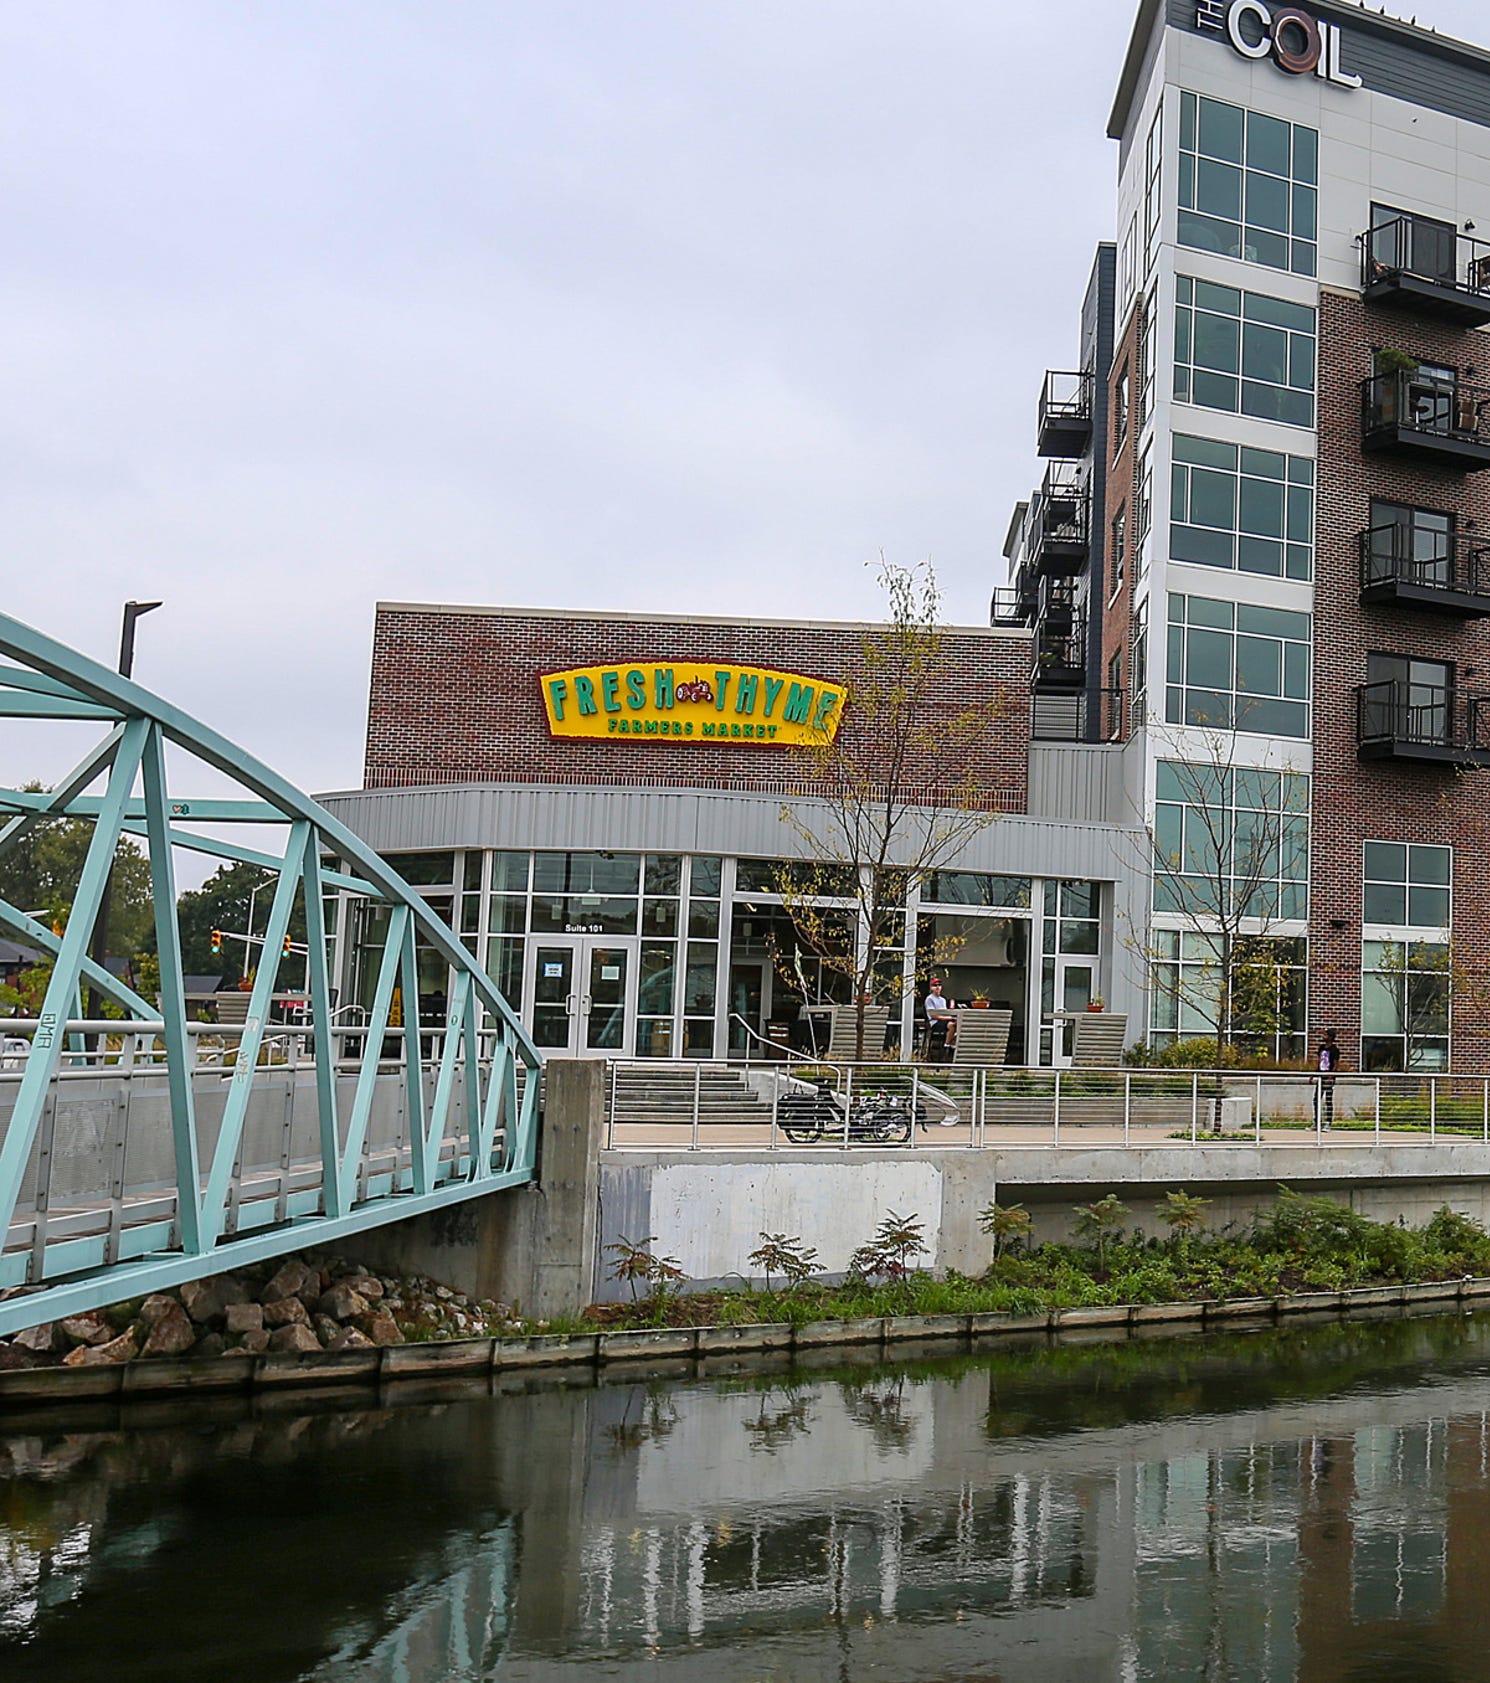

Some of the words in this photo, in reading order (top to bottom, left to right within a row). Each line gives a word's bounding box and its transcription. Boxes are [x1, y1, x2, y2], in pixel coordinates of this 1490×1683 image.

[1228, 0, 1363, 88] COIL
[549, 669, 674, 721] FRESH
[715, 671, 838, 730] THYME
[608, 719, 693, 735] FARMERS
[702, 722, 777, 738] MARKET
[565, 924, 587, 932] Suite
[589, 924, 602, 933] 101
